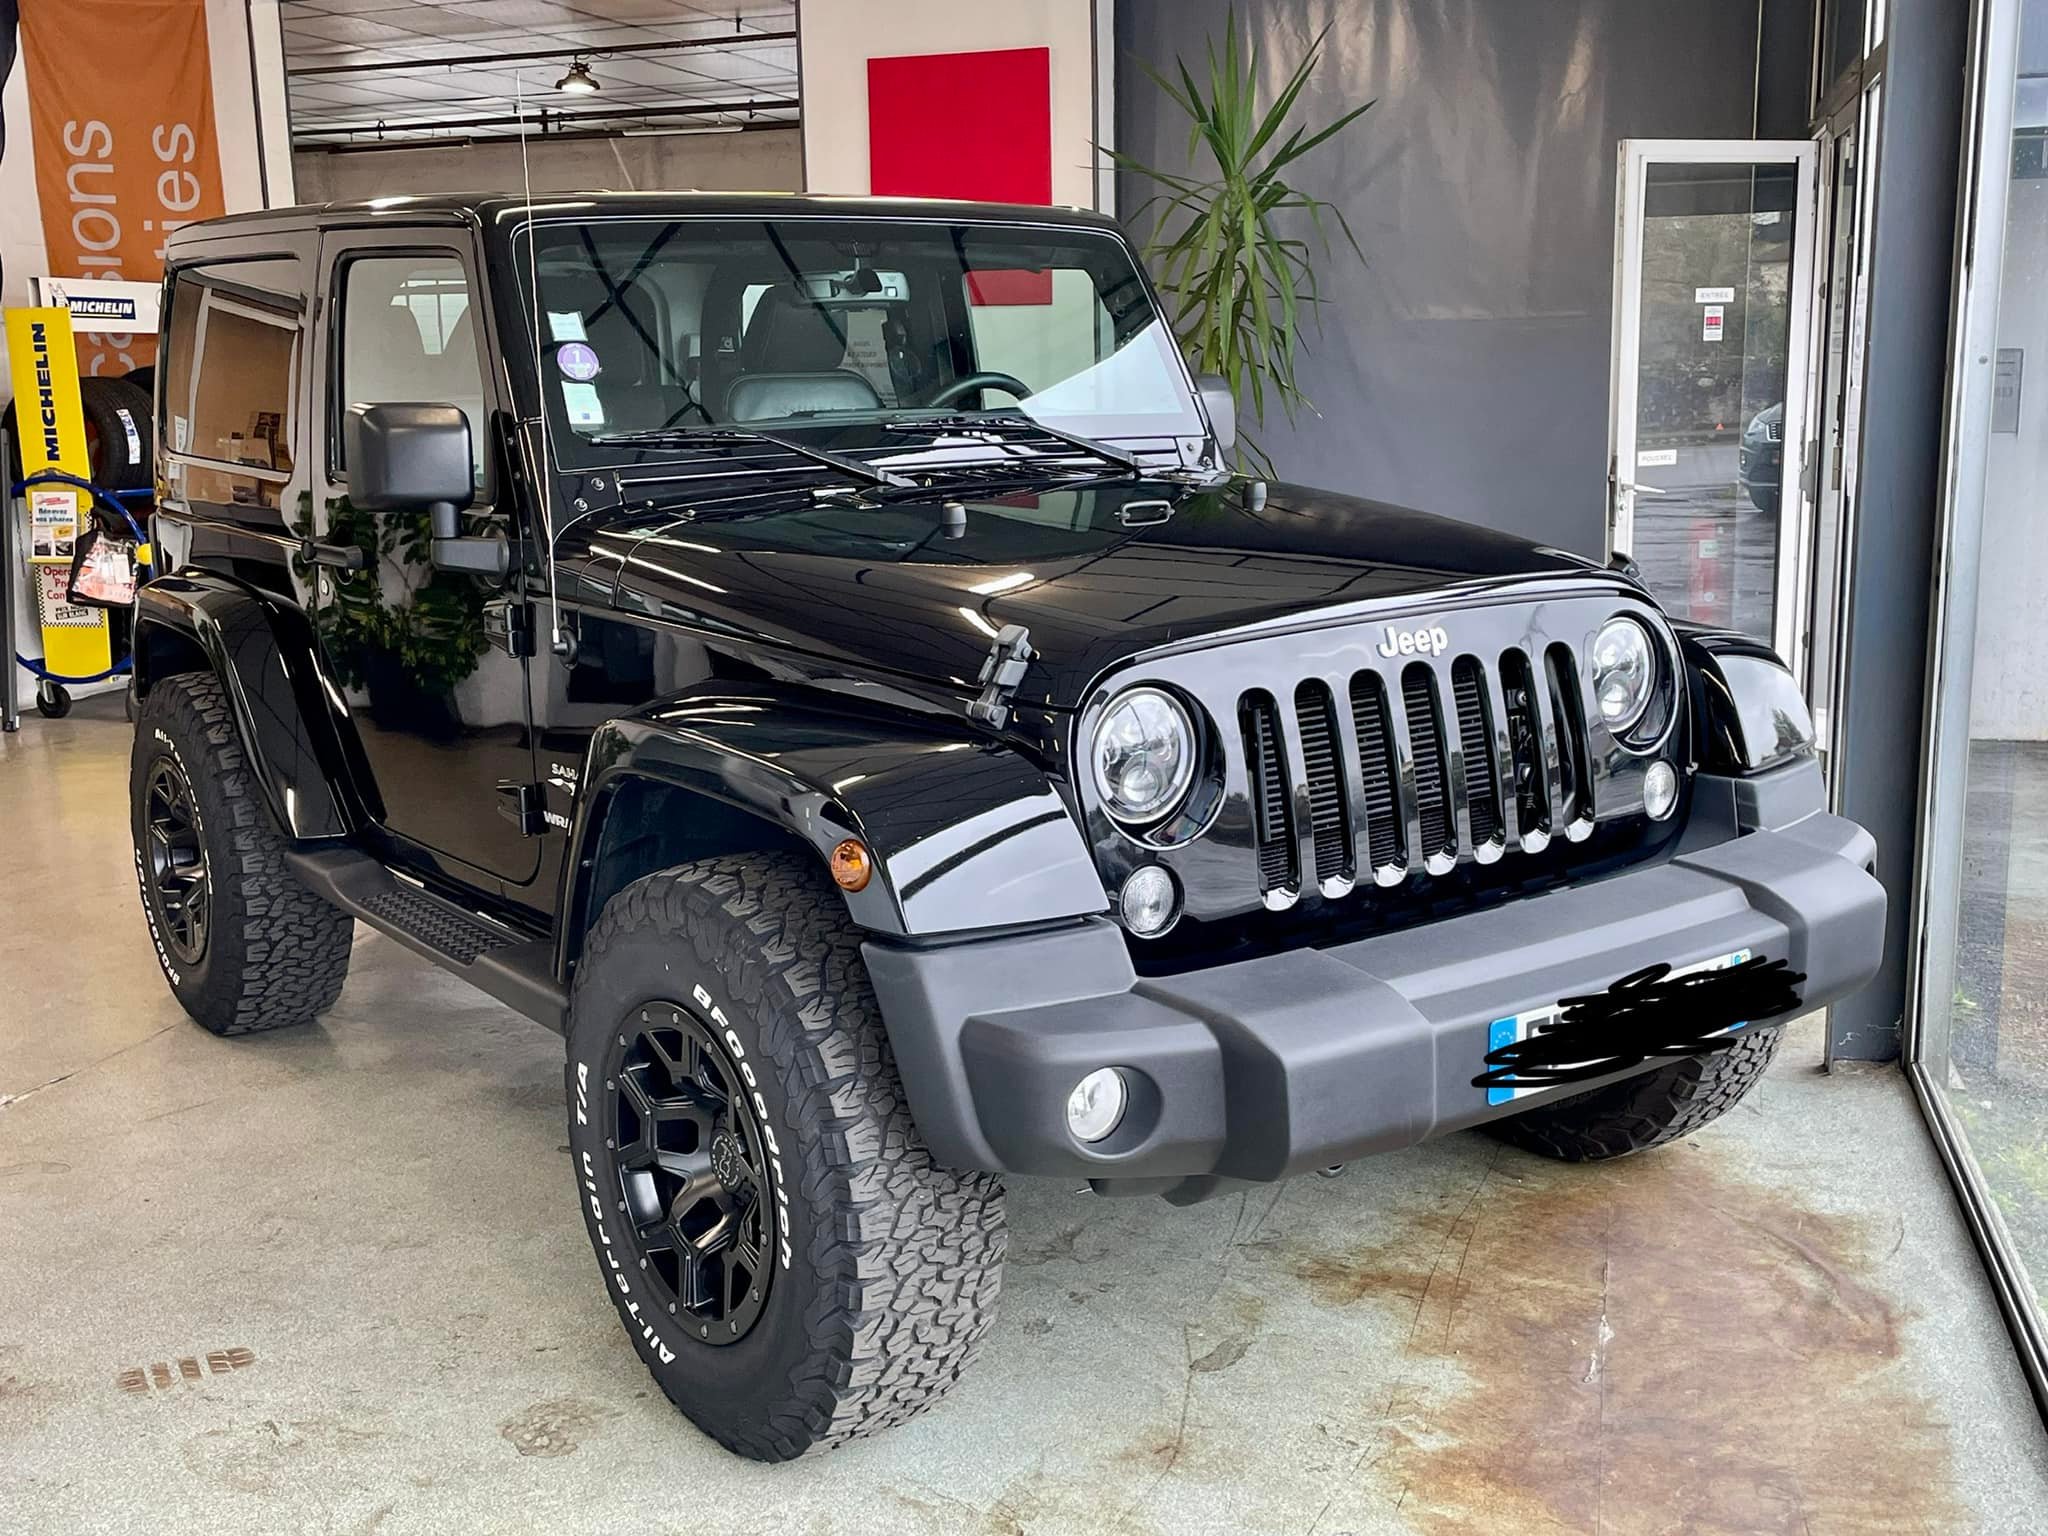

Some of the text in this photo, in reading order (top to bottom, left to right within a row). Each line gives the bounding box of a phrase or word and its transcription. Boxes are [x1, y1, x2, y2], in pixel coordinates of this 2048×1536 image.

[70, 301, 133, 315] MICHELIN
[31, 323, 61, 461] MICHELIN
[1377, 625, 1449, 658] Jeep
[575, 1061, 589, 1127] T/A
[693, 983, 792, 1271] BFGoodrich
[581, 1151, 677, 1367] All-Terrain
